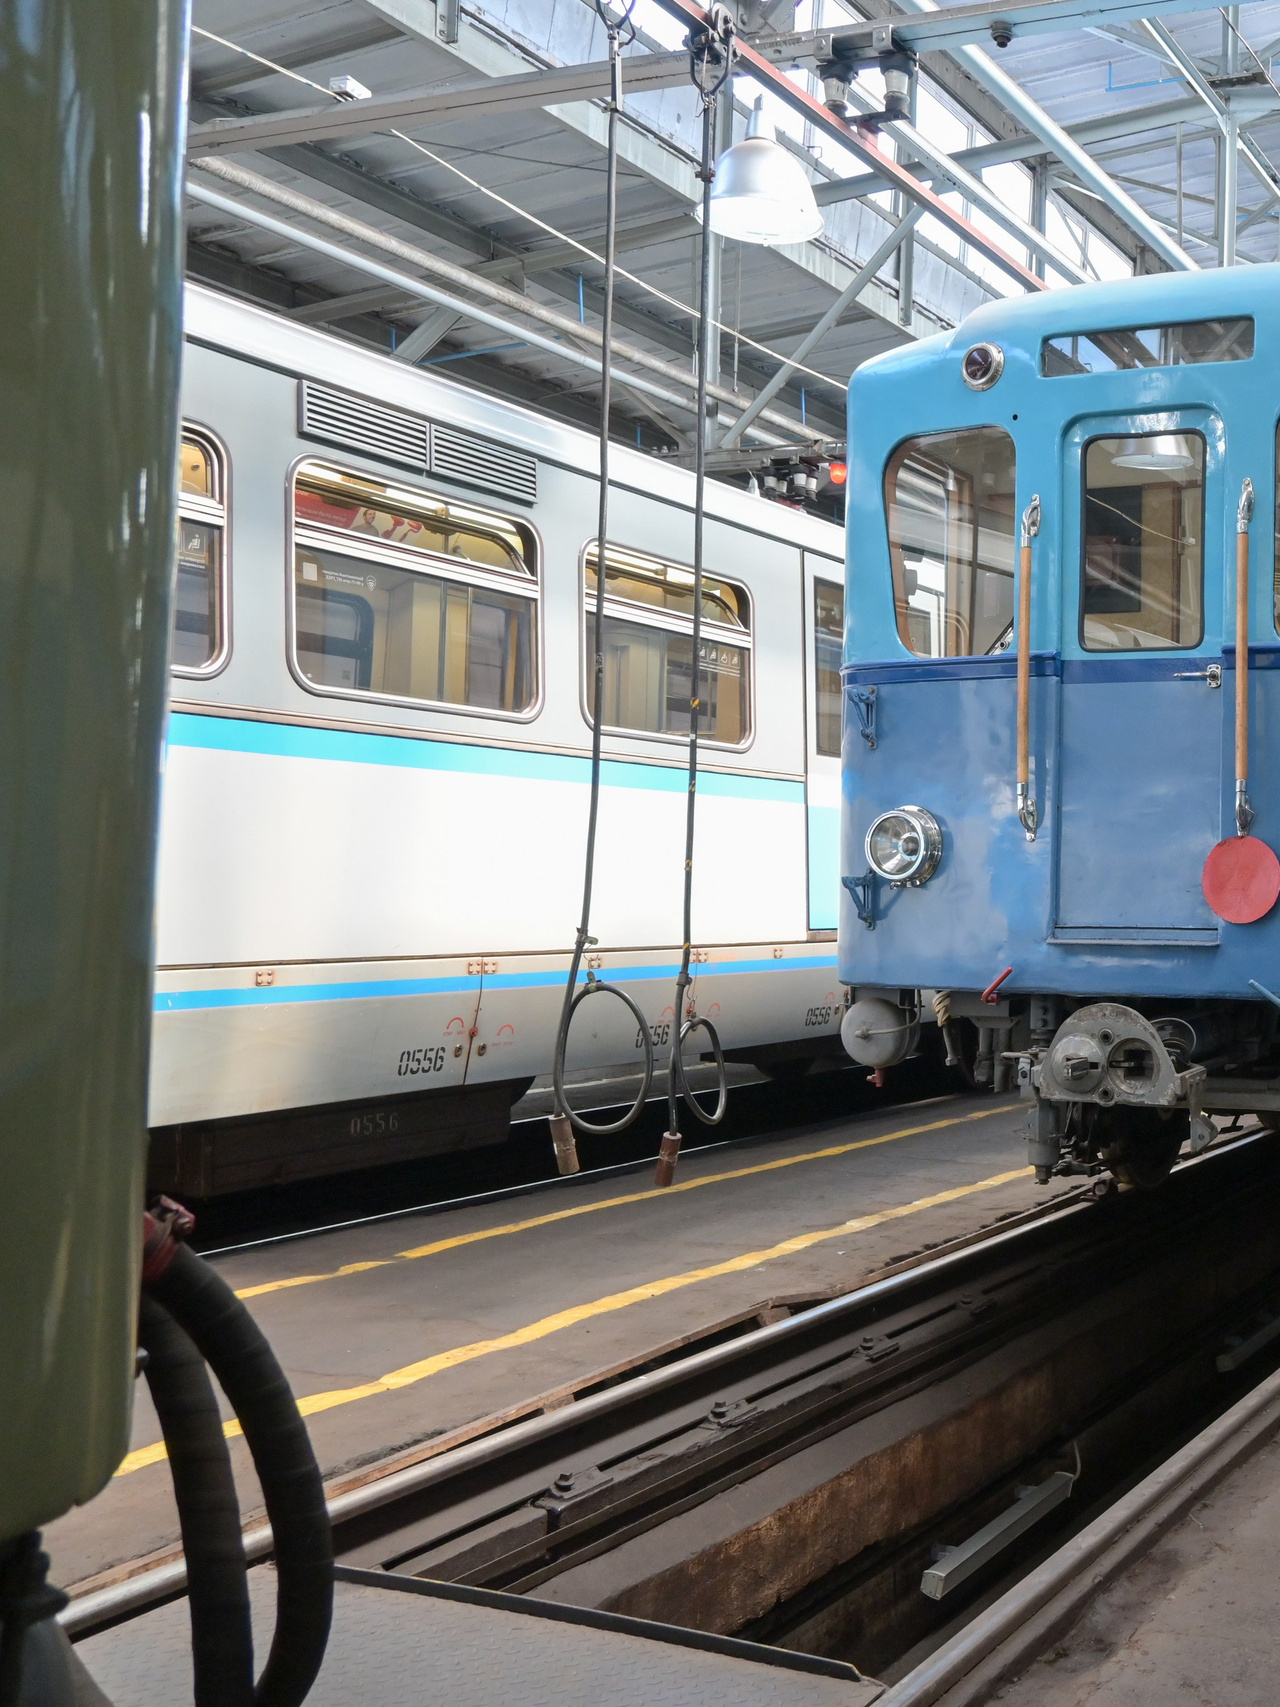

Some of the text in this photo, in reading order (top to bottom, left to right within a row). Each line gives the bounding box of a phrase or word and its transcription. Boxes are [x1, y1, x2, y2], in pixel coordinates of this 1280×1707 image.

[805, 1006, 832, 1026] 0556
[398, 1046, 446, 1076] 0556
[350, 1112, 398, 1137] 0556
